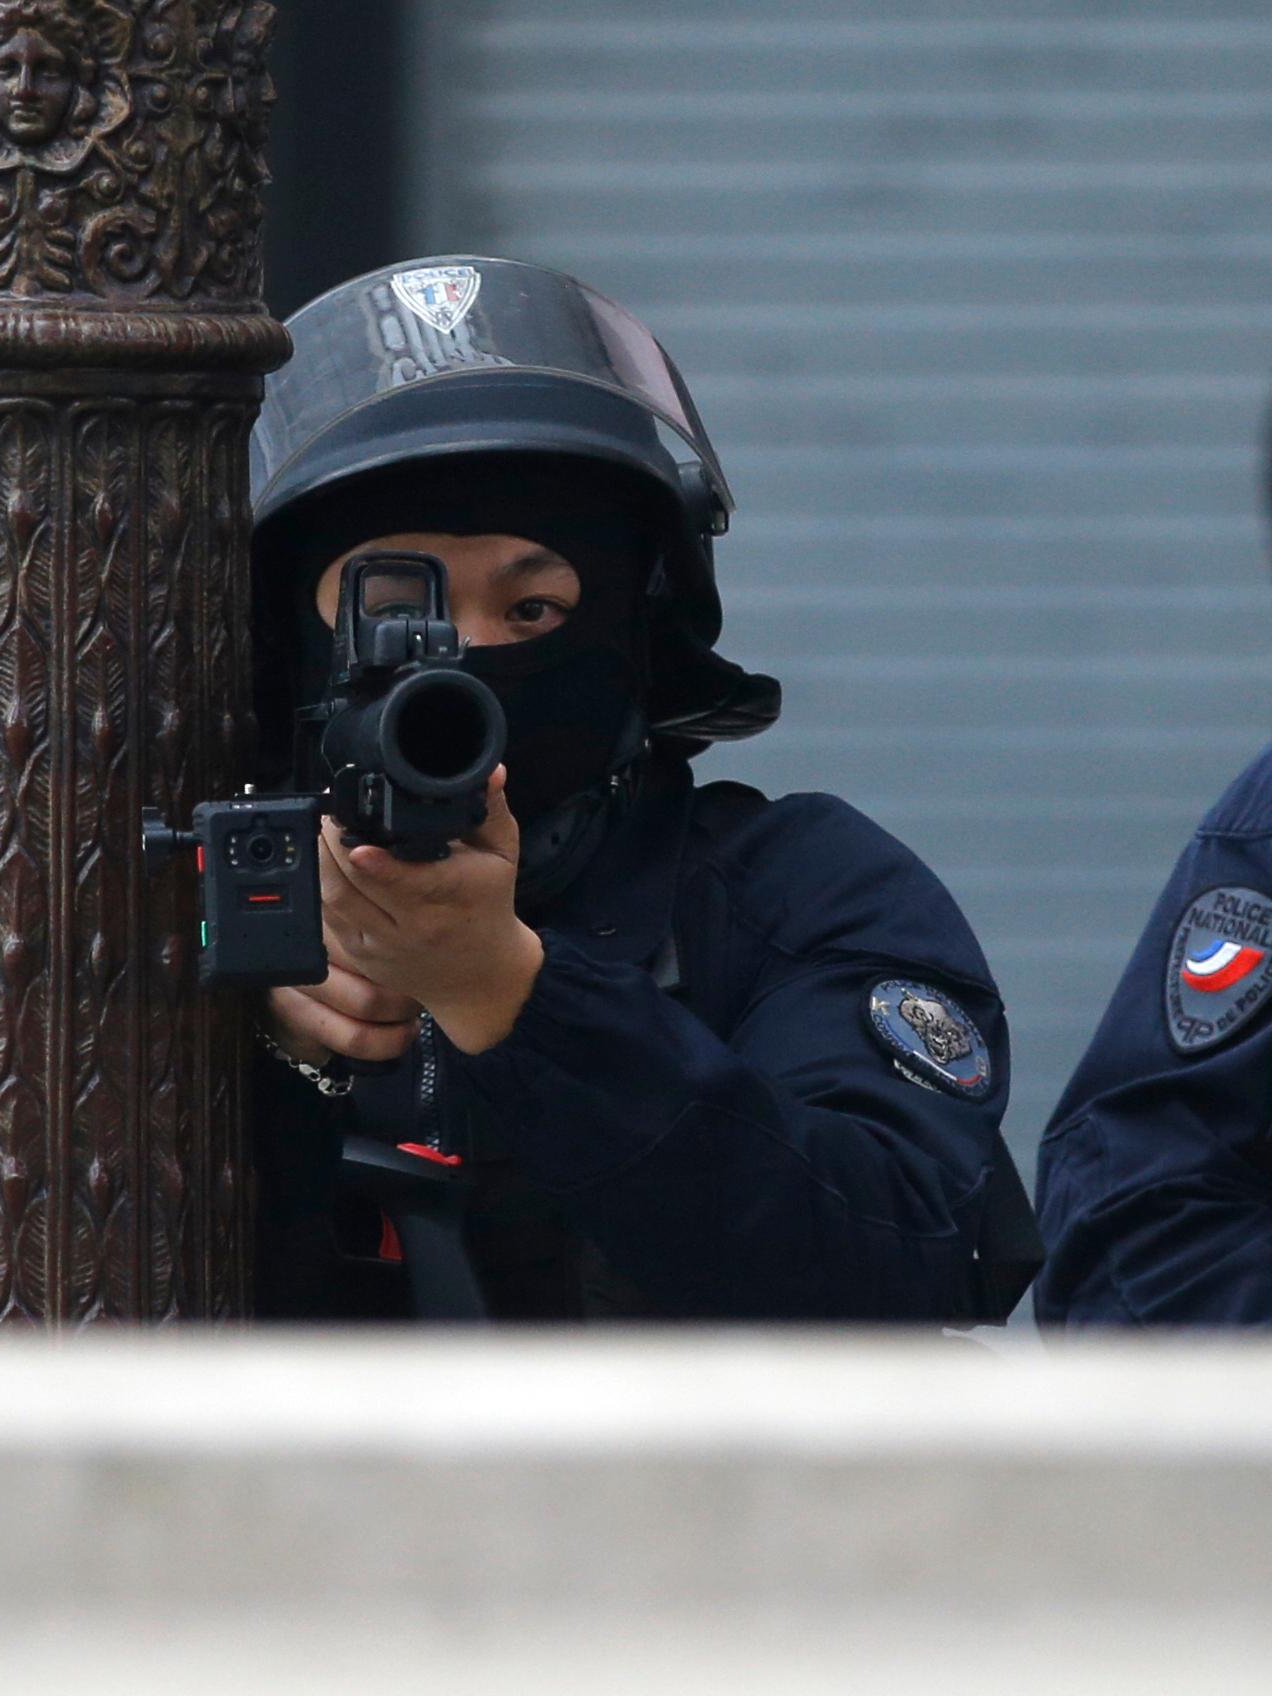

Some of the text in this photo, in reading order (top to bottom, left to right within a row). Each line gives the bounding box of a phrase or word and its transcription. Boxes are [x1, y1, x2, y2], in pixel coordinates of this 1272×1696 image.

[402, 268, 469, 284] POLICE
[1214, 892, 1272, 924] POLICE
[1235, 958, 1272, 1011] POLIC
